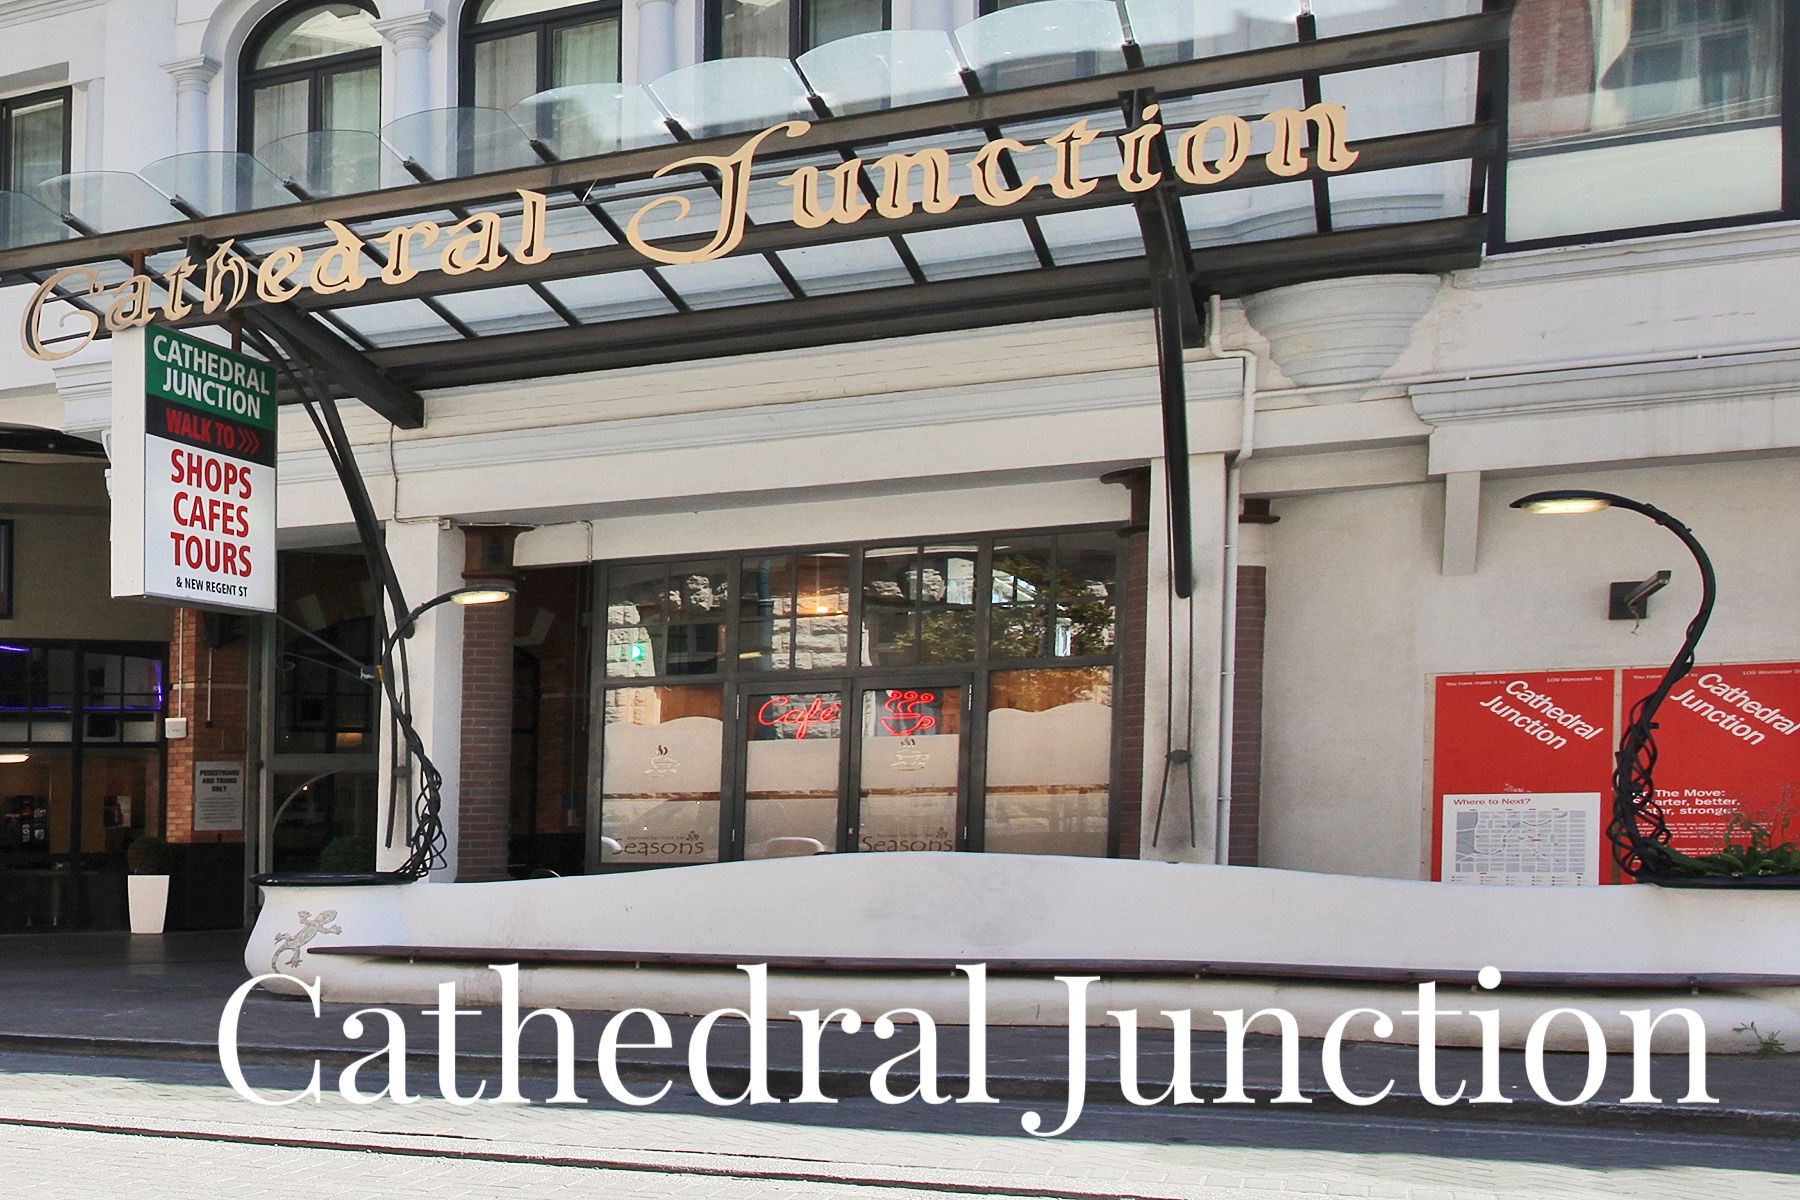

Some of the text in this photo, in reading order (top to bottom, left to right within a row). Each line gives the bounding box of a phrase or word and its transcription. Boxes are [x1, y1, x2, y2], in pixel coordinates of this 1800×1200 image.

[21, 103, 1360, 361] Cathedral Junction
[153, 335, 270, 395] CATHEDRAL
[163, 367, 260, 419] JUNCTION
[166, 408, 236, 449] WALK TO
[171, 448, 252, 500] SHOPS
[173, 491, 249, 538] CAFES
[170, 532, 252, 578] TOURS
[176, 577, 248, 597] & NEW REGENT ST
[1480, 696, 1568, 749] Junction
[1505, 680, 1604, 740] Cathedral
[1670, 689, 1766, 745] Junction
[1698, 673, 1800, 735] Cathedral
[1655, 789, 1680, 797] The
[1684, 789, 1726, 797] Move:
[1695, 798, 1741, 806] better.
[862, 836, 953, 852] Seasons
